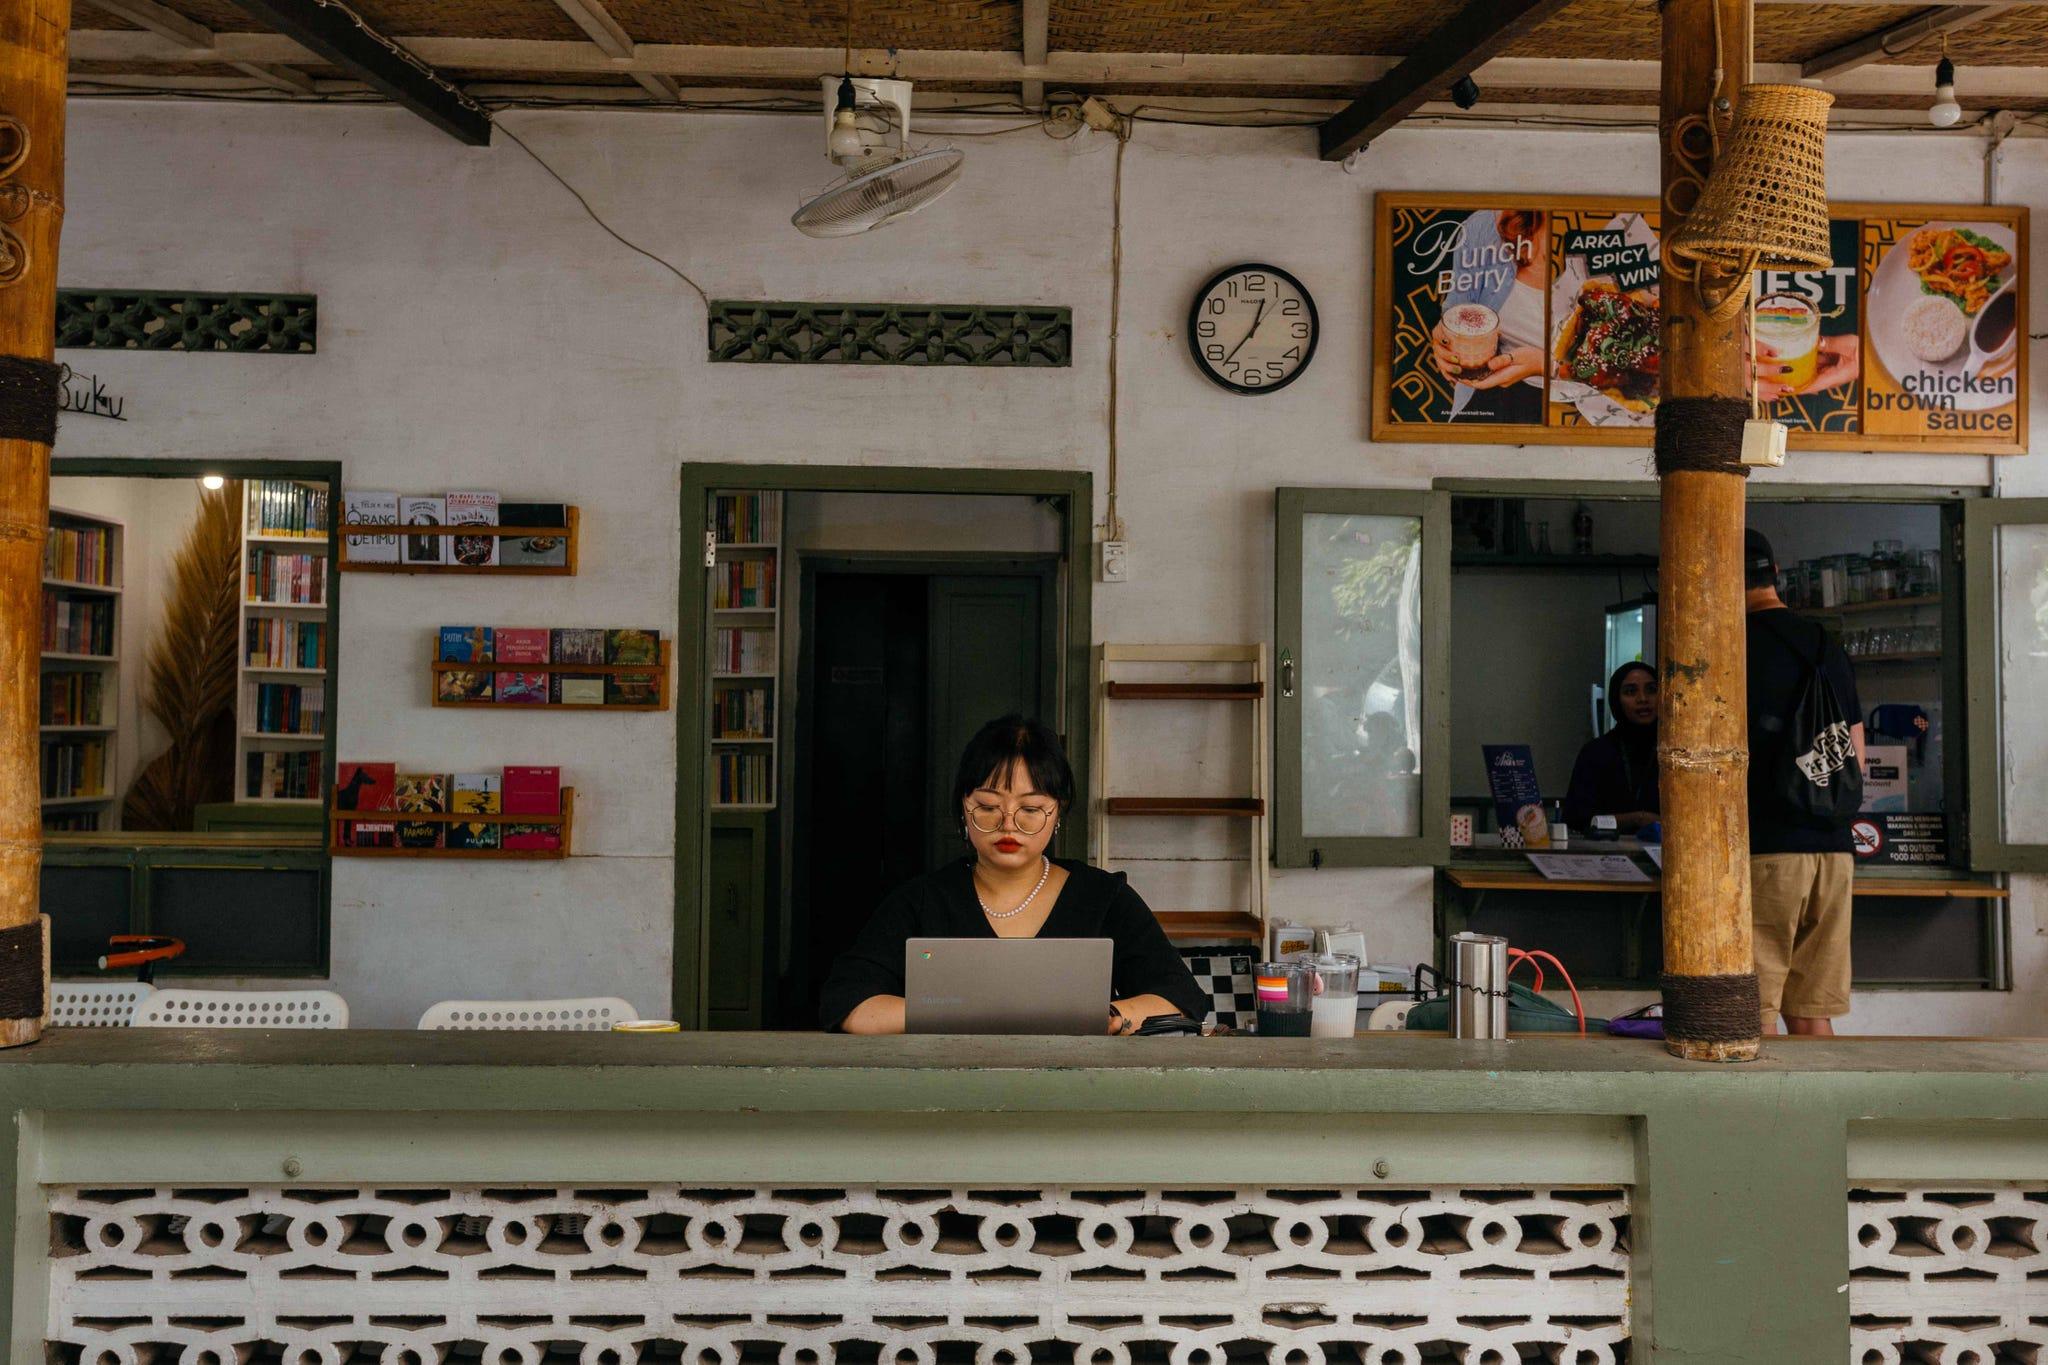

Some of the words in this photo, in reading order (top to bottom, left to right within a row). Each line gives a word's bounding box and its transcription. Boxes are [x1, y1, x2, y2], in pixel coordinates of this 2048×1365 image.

[1407, 219, 1532, 275] Punch
[1570, 234, 1622, 250] ARKA
[1591, 247, 1645, 270] SPICY
[1243, 274, 1266, 292] 12
[1438, 268, 1508, 294] Berry
[1619, 264, 1660, 287] WIN
[1226, 281, 1238, 298] 11
[1273, 281, 1279, 298] 1
[1207, 298, 1226, 315] 10
[1282, 299, 1300, 316] 2
[1199, 321, 1216, 338] 9
[1291, 322, 1309, 339] 3
[1207, 344, 1225, 361] 8
[1282, 345, 1300, 362] 4
[1226, 361, 1240, 378] 7
[1244, 368, 1262, 386] 6
[1266, 361, 1284, 379] 5
[1901, 369, 2014, 394] chicken
[1866, 387, 1956, 411] brown
[1926, 412, 2014, 431] sauce
[1890, 852, 1909, 861] FOOD
[1910, 853, 1924, 861] AND
[1898, 844, 1908, 852] NO
[1909, 844, 1936, 852] OUTSIDE
